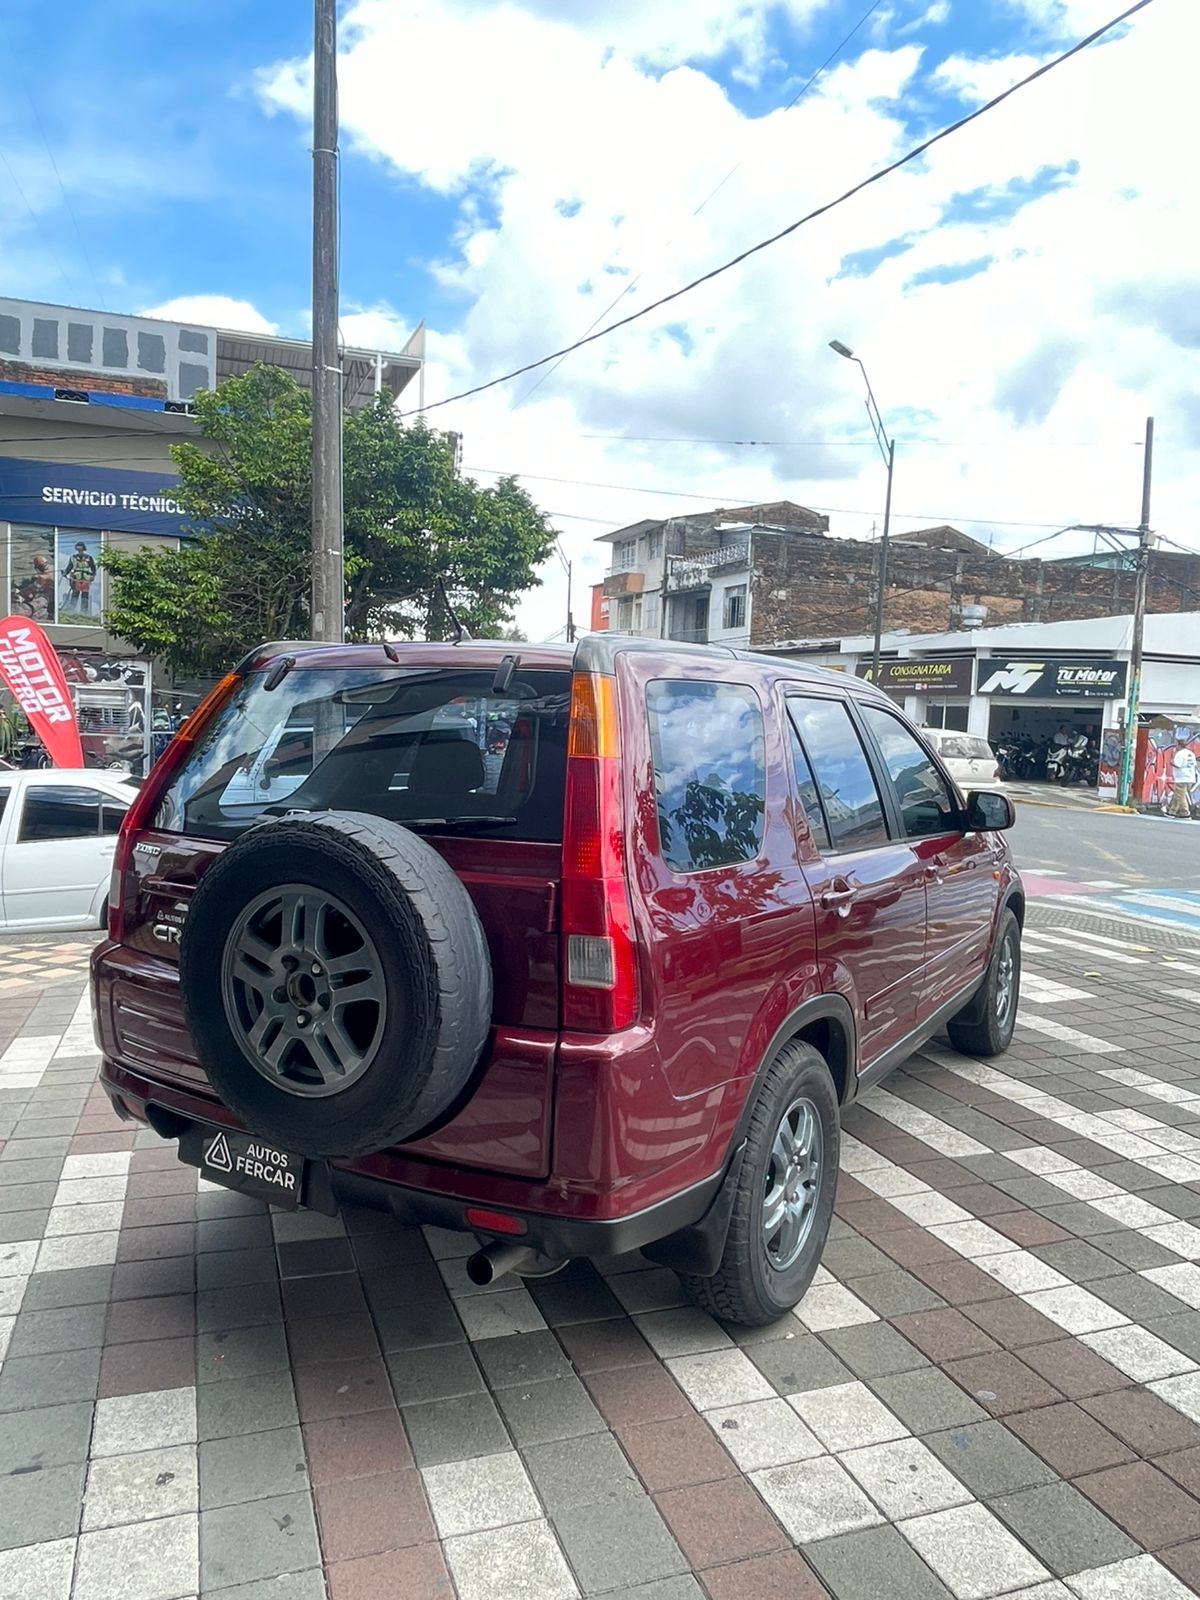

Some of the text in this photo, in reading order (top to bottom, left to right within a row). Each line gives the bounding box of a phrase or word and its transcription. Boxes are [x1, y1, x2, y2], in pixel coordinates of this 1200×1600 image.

[42, 486, 116, 507] SERVICIO
[0, 638, 43, 713] CUATRO
[7, 627, 73, 724] MOTOR
[889, 663, 953, 676] CONSIGNATARIA
[246, 1143, 289, 1168] AUTOS
[235, 1156, 296, 1191] FERCAR
